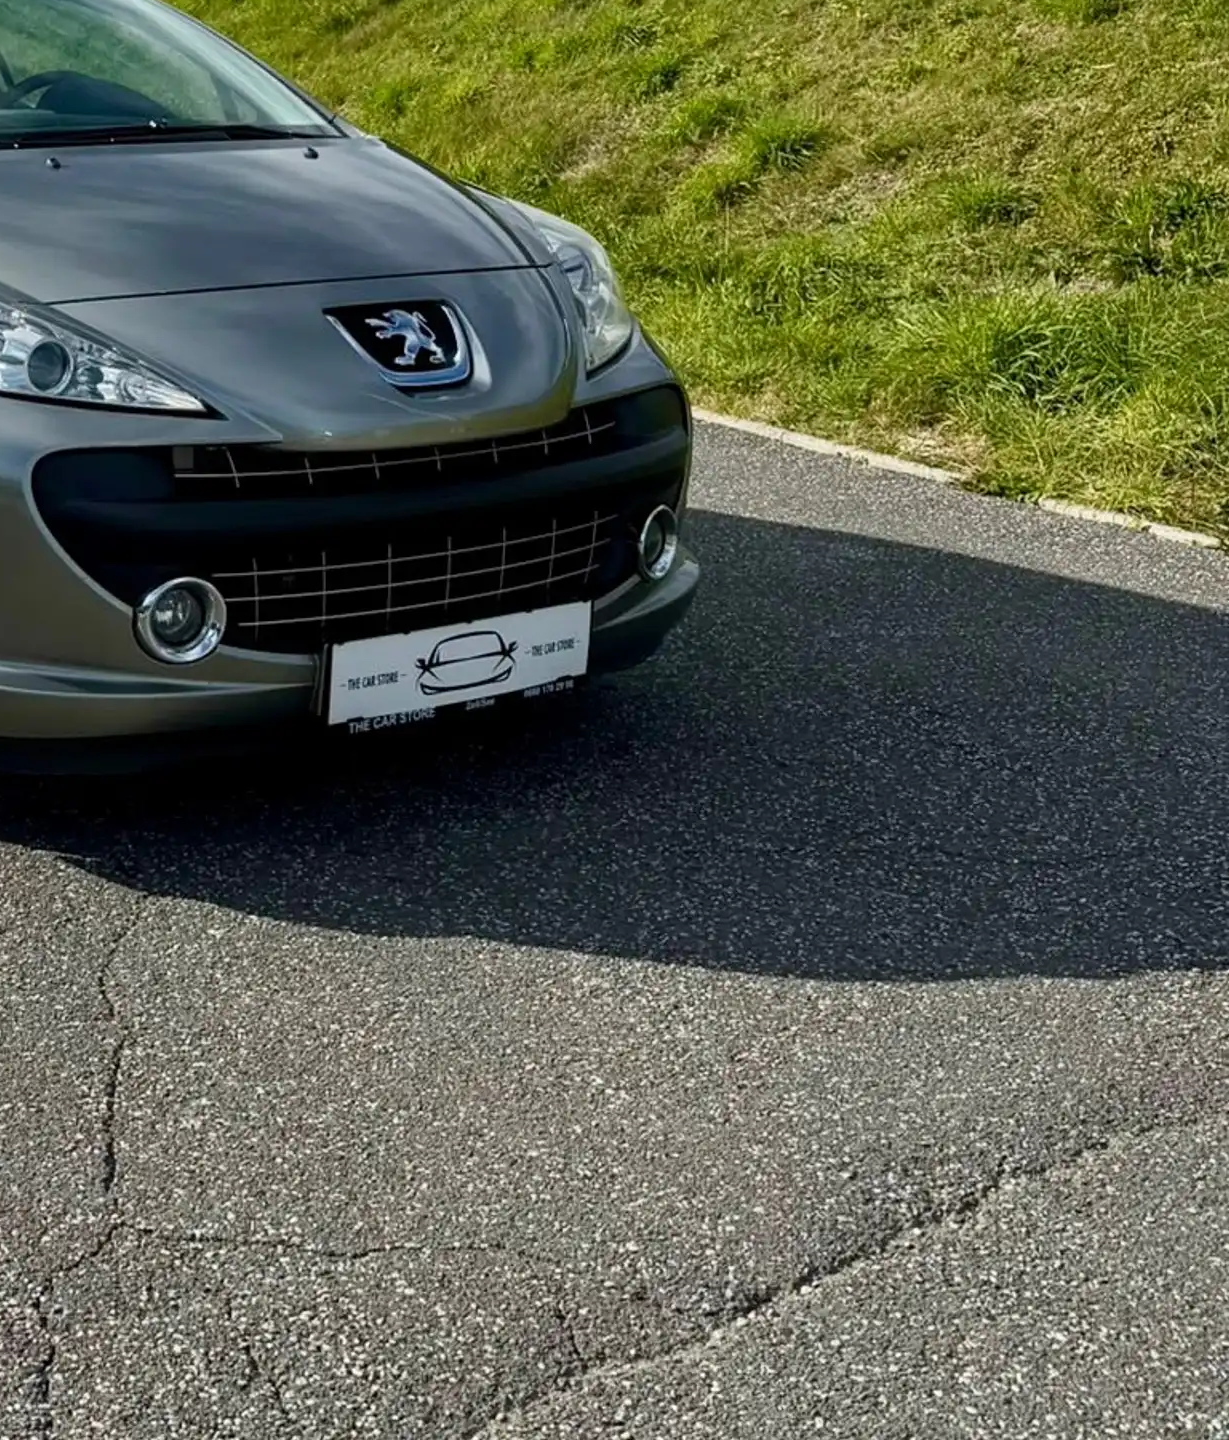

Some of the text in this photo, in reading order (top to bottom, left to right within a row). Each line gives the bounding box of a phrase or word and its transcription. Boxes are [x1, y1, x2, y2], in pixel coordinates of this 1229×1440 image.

[347, 707, 436, 734] THE CAR STORE
